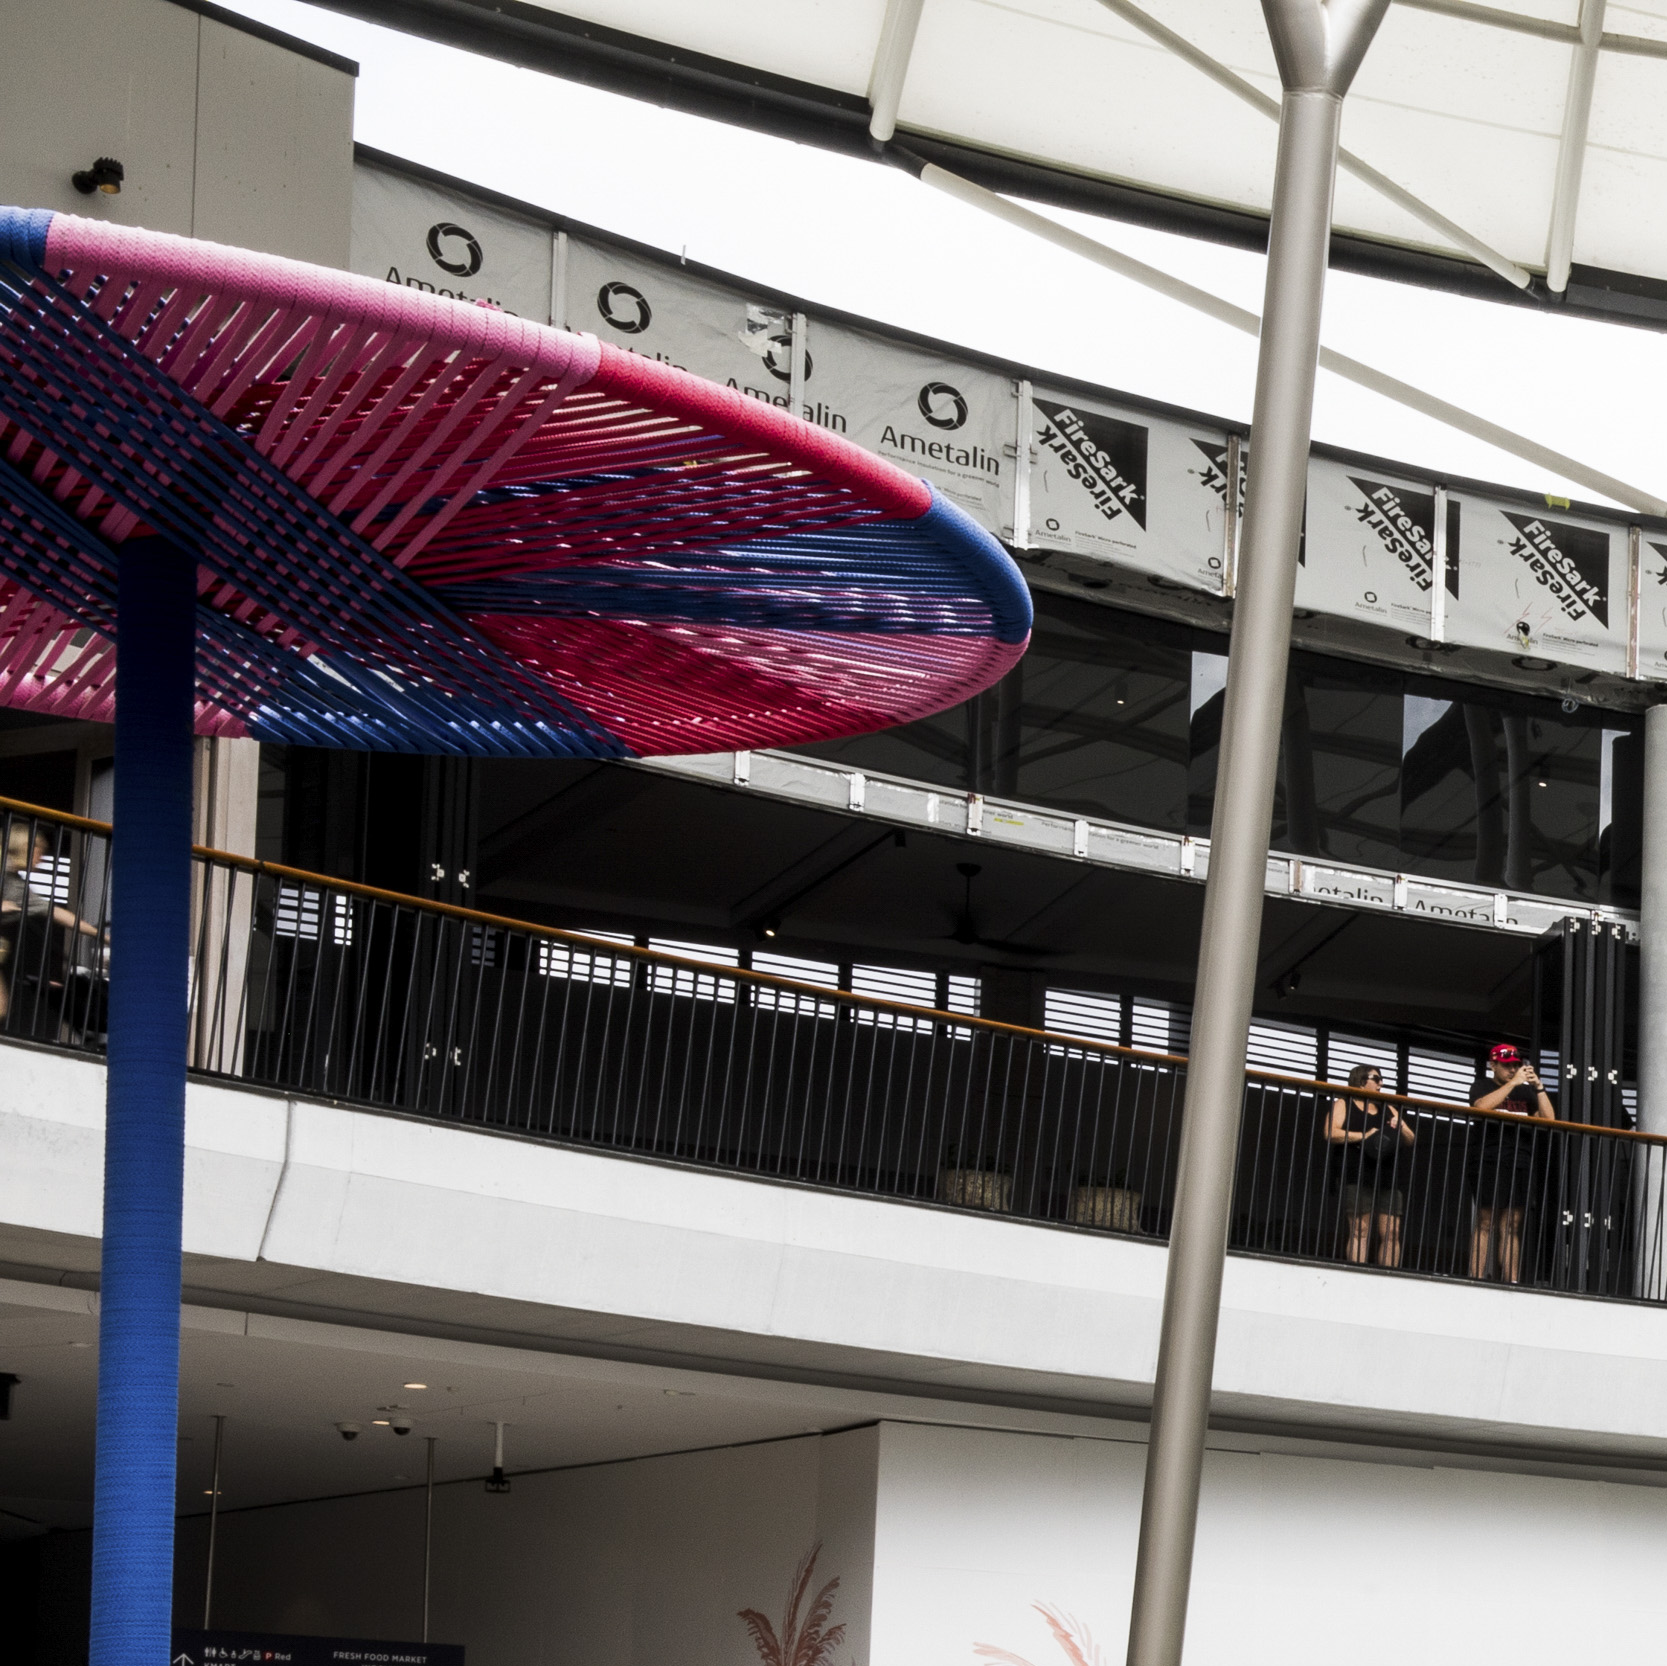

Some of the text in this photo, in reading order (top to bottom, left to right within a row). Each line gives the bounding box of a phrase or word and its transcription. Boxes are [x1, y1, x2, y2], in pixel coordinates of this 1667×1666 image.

[726, 378, 847, 433] Amealin
[880, 425, 1000, 476] Ametalin
[1037, 424, 1122, 521] FireSark
[1053, 409, 1139, 505] FireSark
[1507, 536, 1586, 622] FireSark
[1523, 520, 1600, 607] FireSark
[274, 1653, 291, 1661] Red
[333, 1651, 427, 1664] FRESH FOOD MARKET
